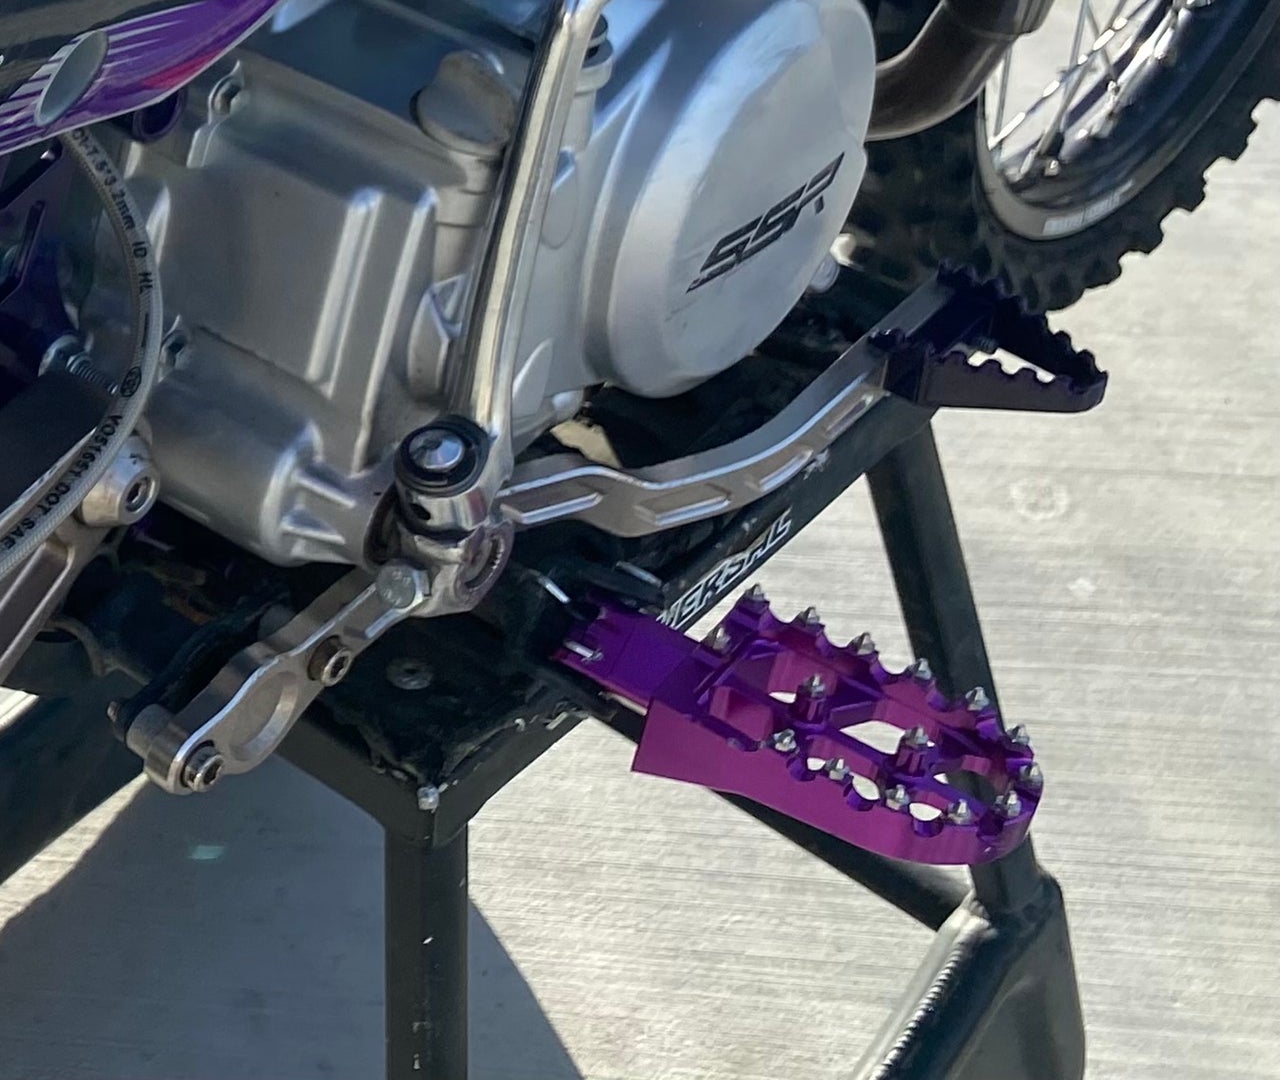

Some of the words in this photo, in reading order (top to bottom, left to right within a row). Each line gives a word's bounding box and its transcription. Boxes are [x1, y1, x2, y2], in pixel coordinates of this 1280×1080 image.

[685, 151, 845, 294] SSR
[37, 482, 71, 516] DOT
[1, 517, 36, 549] SAE
